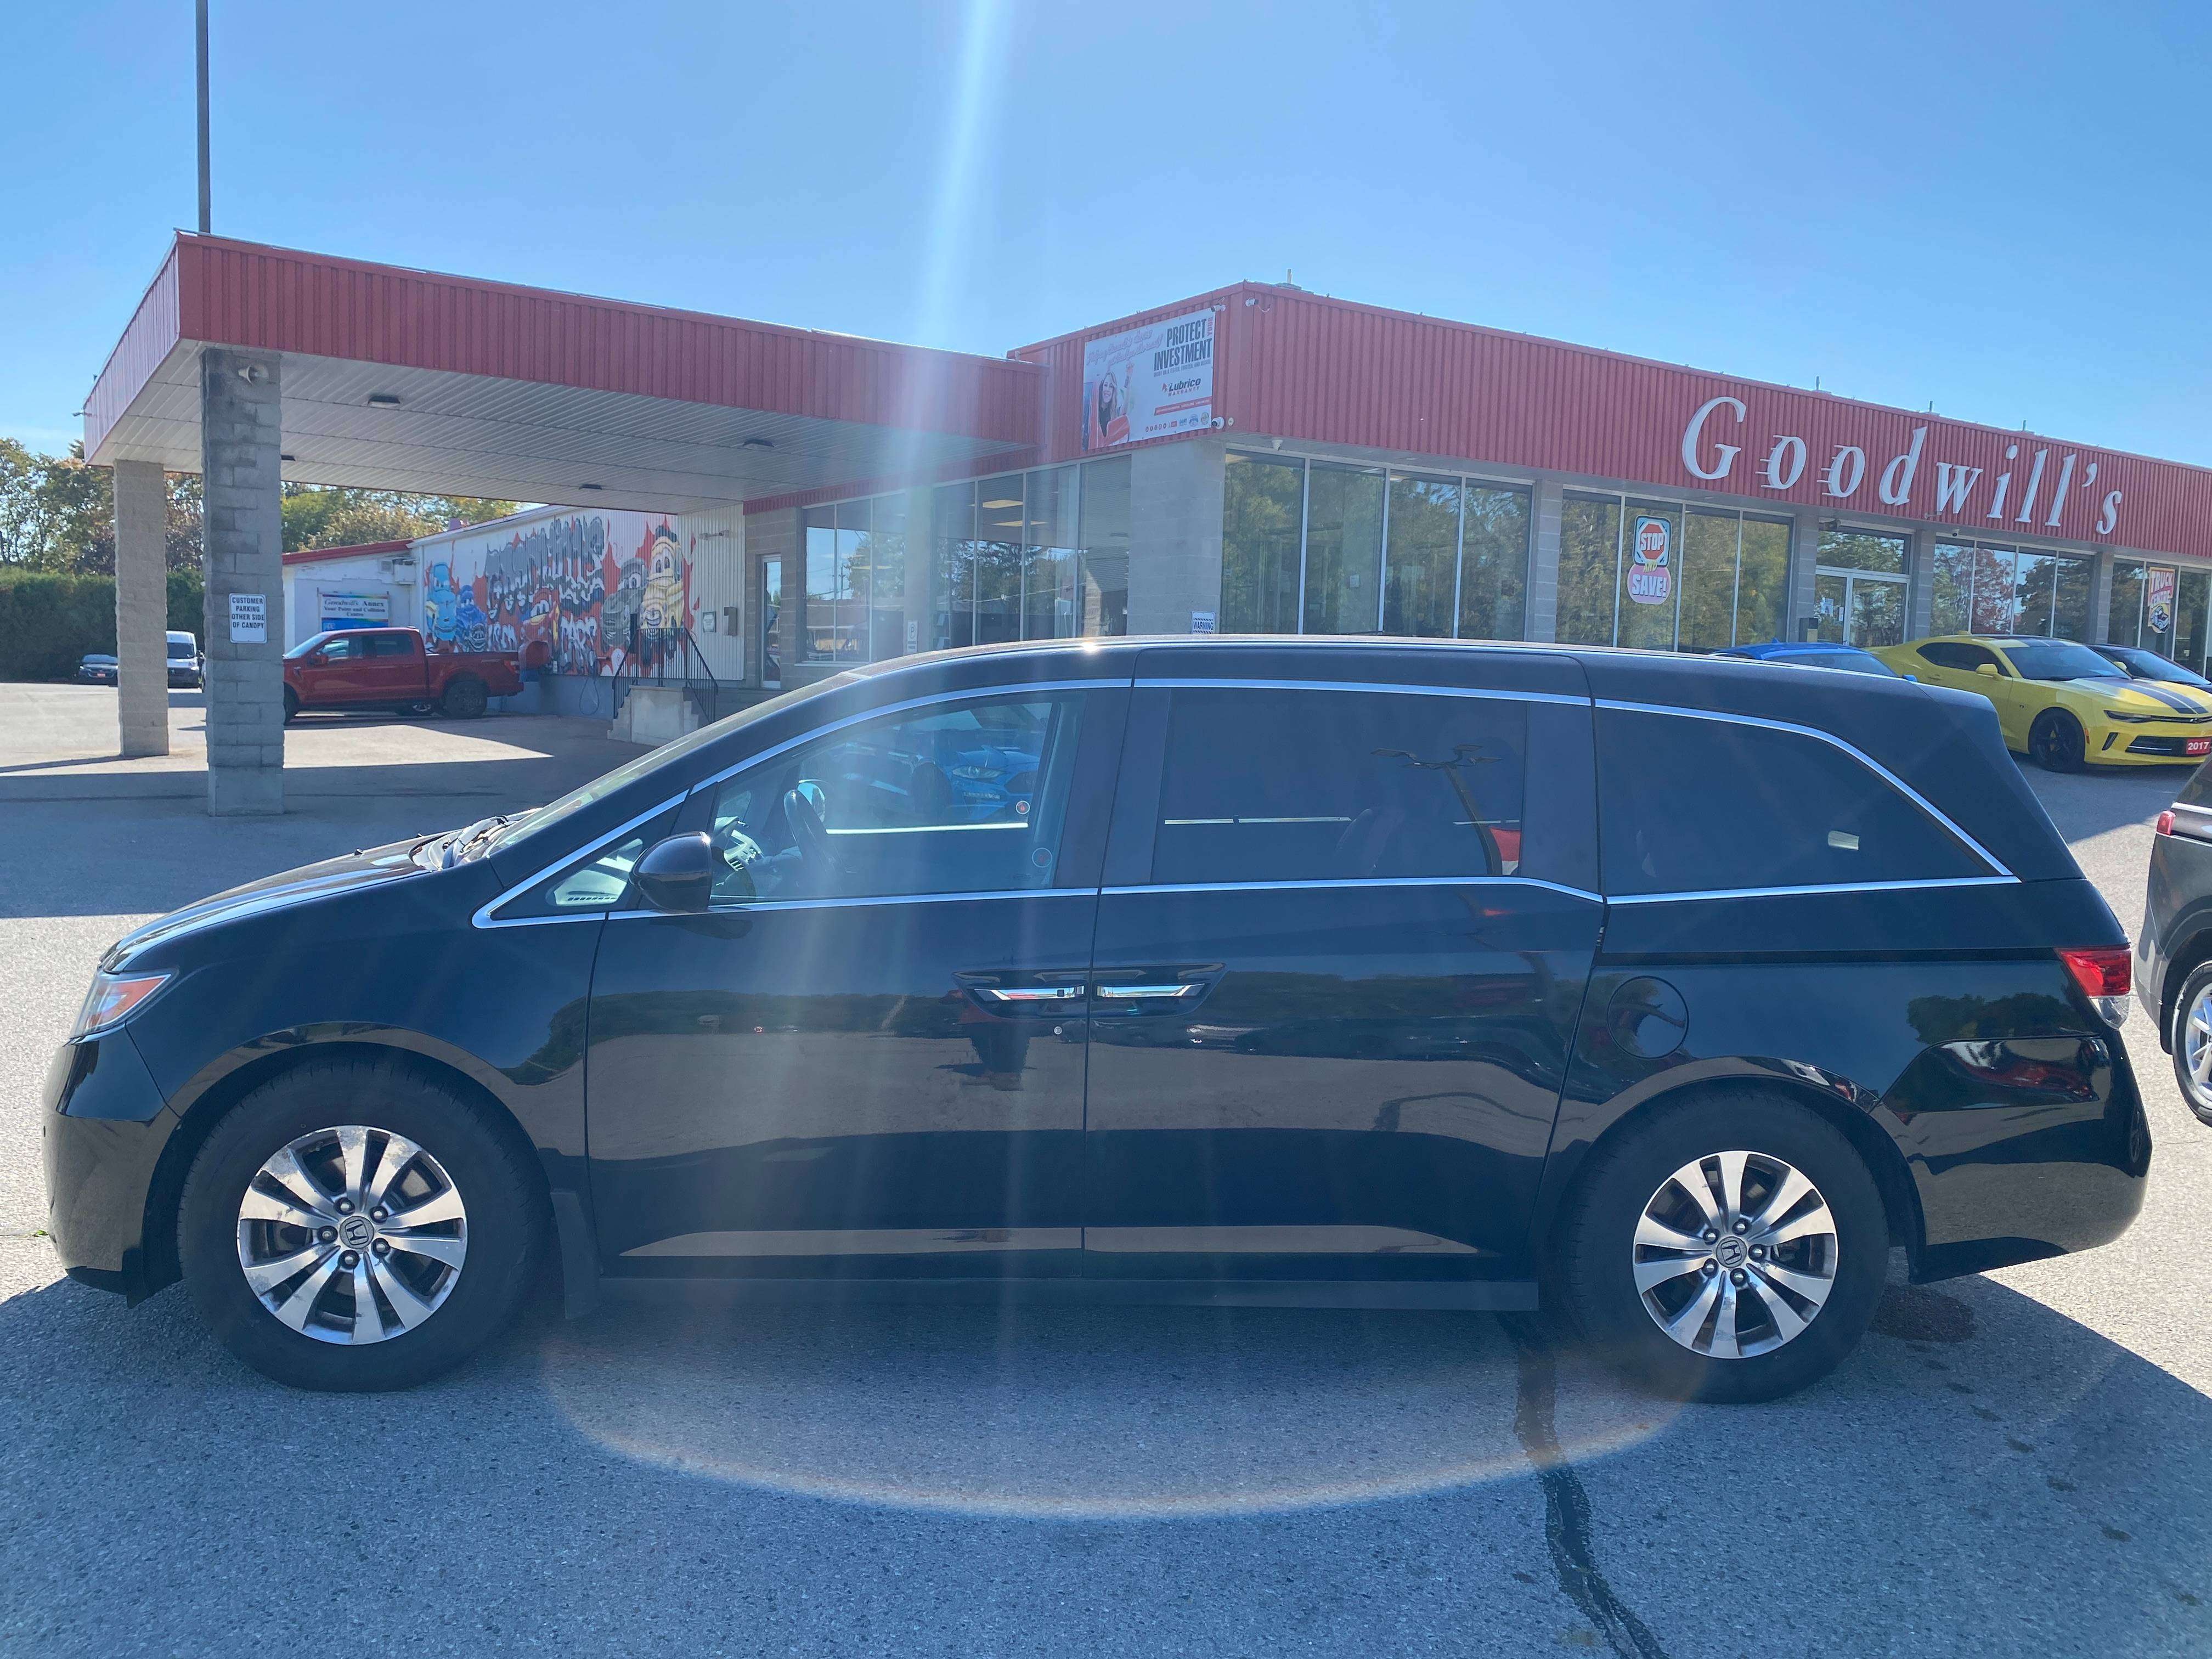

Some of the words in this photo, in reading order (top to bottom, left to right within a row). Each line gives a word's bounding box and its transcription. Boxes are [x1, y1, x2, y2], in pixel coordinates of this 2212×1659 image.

[1166, 318, 1207, 347] PROTECT
[1154, 338, 1212, 371] INVESTMENT
[1169, 378, 1201, 392] Lubrico
[1681, 396, 2123, 535] Goodwill's
[1640, 533, 1664, 551] STOP
[1643, 561, 1657, 573] AND
[1632, 574, 1667, 598] SAVE!
[2151, 571, 2173, 593] TRUCK
[1193, 621, 1214, 630] WARNING
[2188, 742, 2209, 751] 2017
